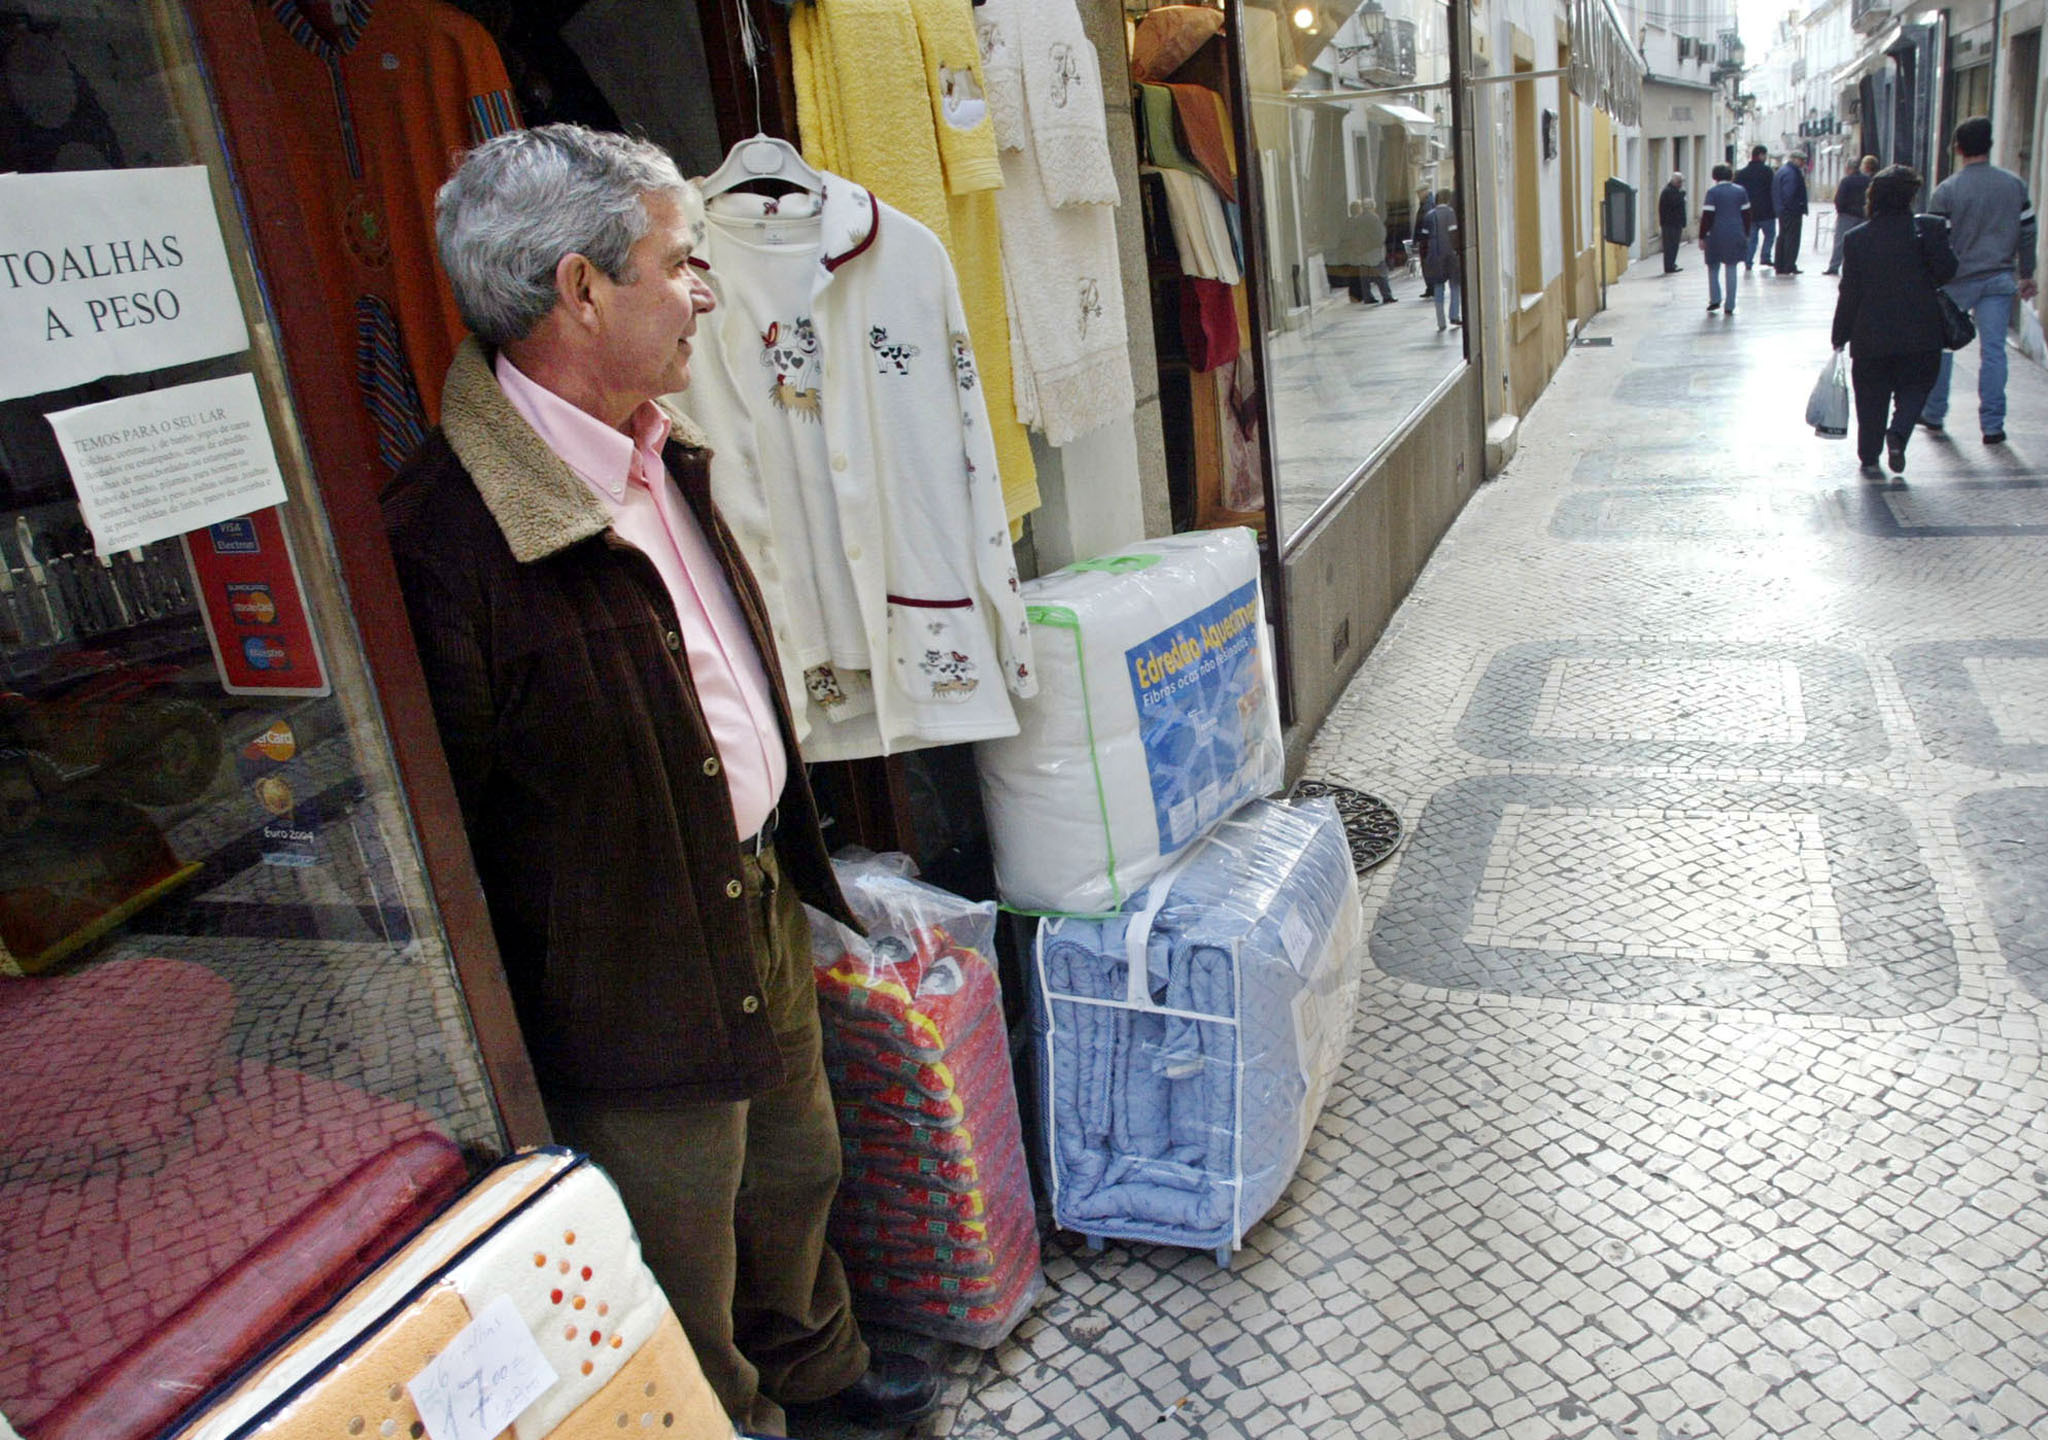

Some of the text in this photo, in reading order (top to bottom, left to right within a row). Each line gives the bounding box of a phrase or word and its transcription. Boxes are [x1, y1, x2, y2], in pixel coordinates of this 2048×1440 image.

[0, 235, 184, 288] TOALHAS
[46, 288, 181, 341] A PESO
[74, 408, 225, 451] TEMOS PARA O SEU LAR
[219, 522, 241, 533] VISA
[1136, 631, 1202, 689] Edredão
[1142, 682, 1177, 707] Fibras
[1177, 669, 1200, 689] ocas
